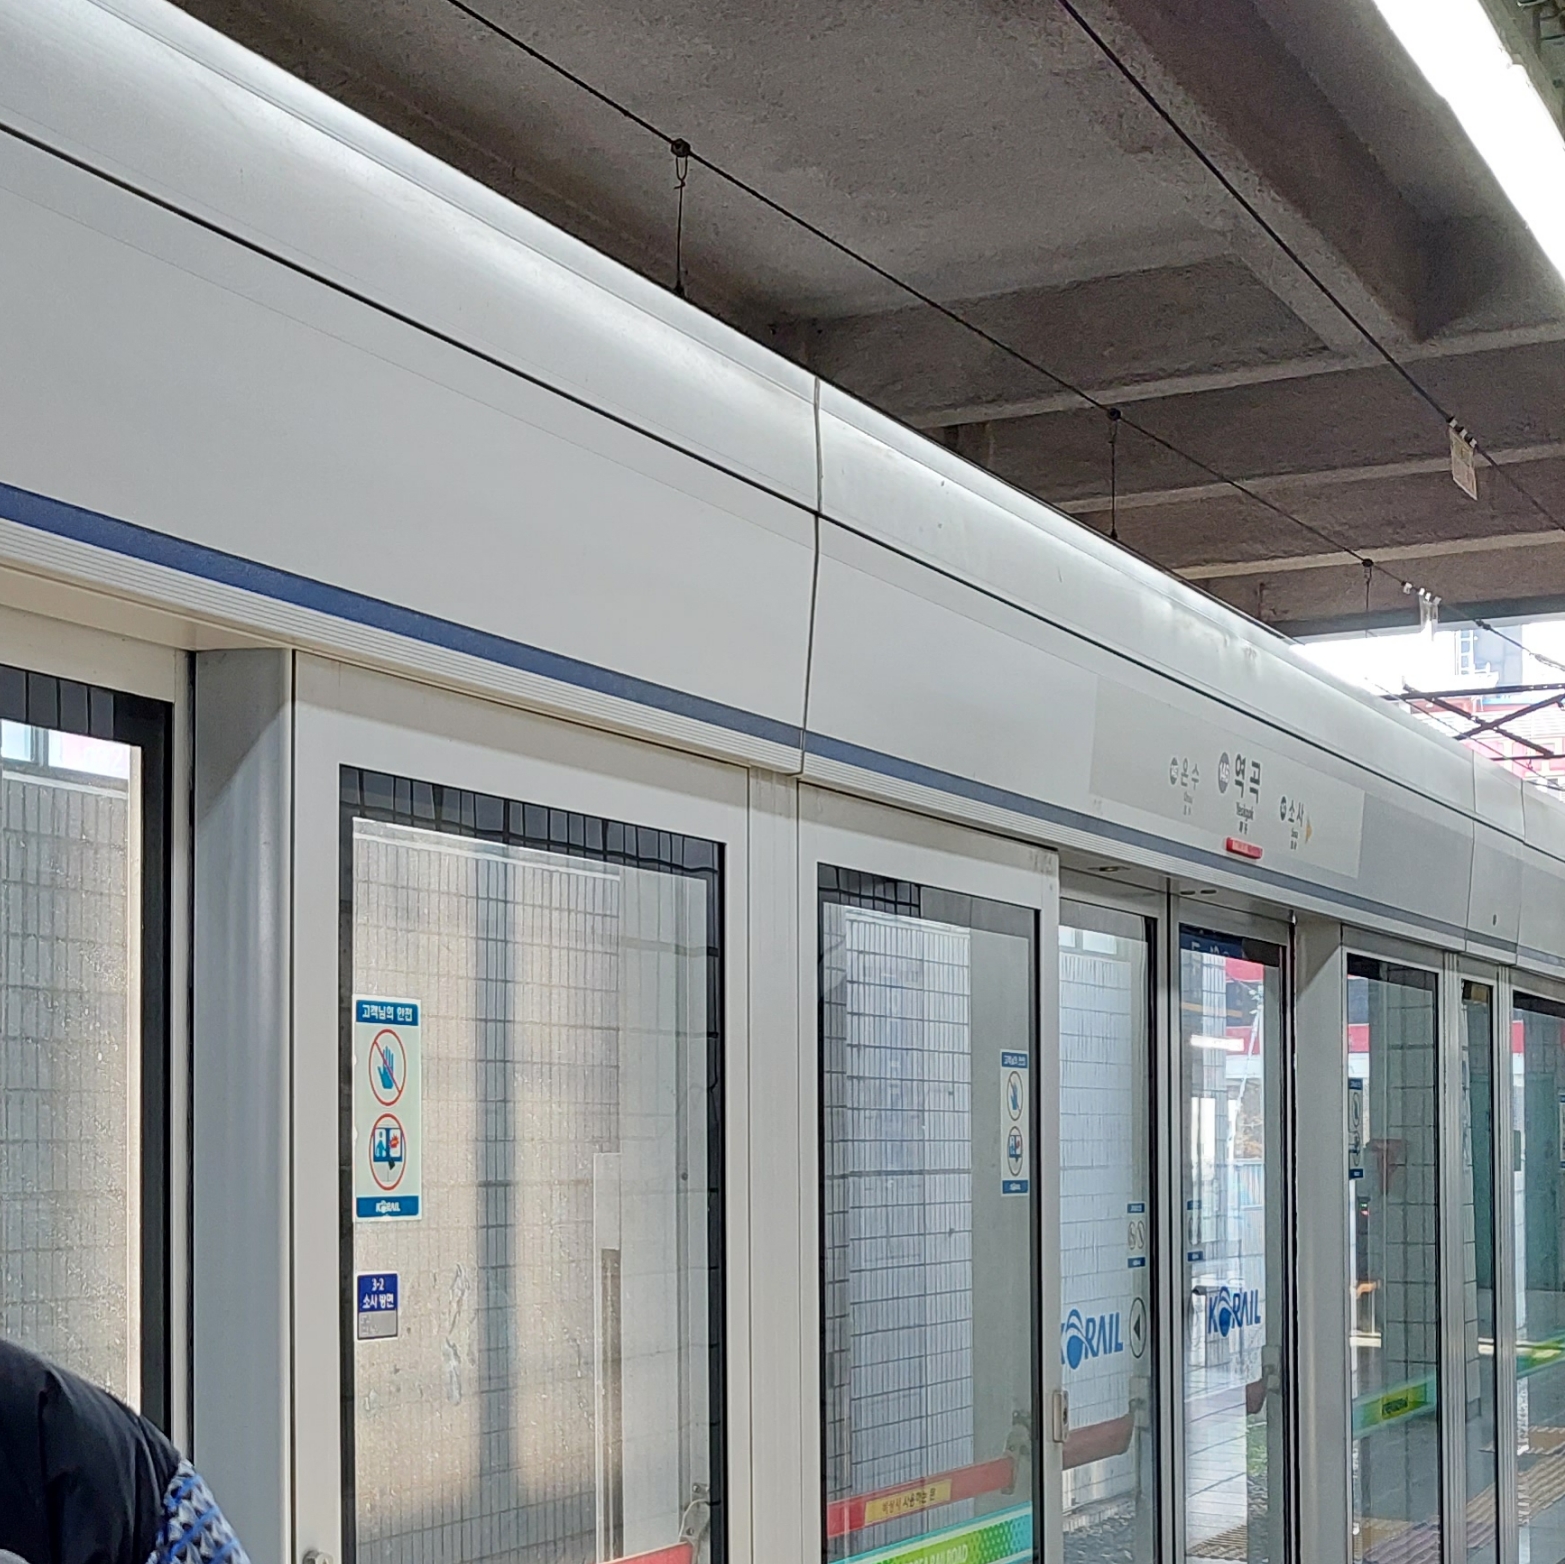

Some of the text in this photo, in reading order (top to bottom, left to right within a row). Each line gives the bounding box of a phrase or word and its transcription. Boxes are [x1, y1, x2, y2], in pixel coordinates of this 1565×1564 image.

[1234, 753, 1261, 804] 역곡
[1288, 799, 1305, 828] 소사
[362, 1004, 413, 1022] 고객님의 안전
[371, 1277, 385, 1292] 3-2
[362, 1292, 395, 1310] 소사 방면
[1207, 1285, 1262, 1338] KORAIL
